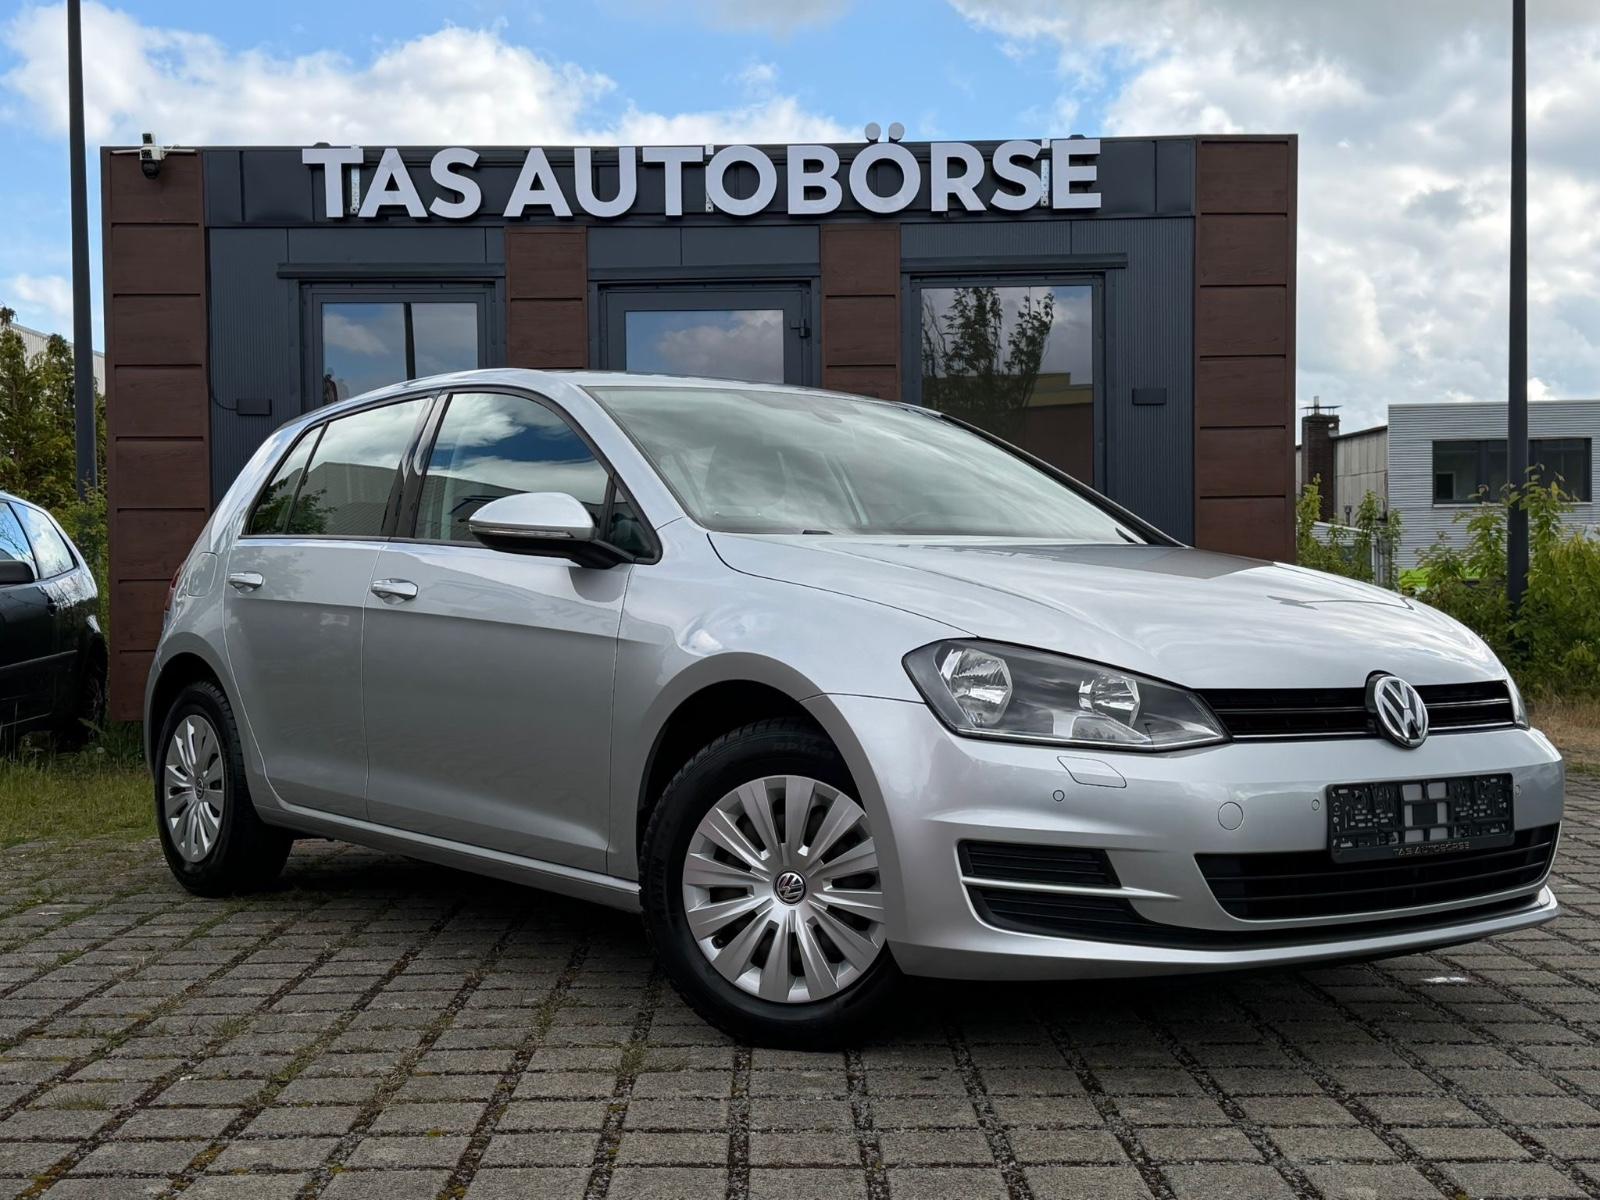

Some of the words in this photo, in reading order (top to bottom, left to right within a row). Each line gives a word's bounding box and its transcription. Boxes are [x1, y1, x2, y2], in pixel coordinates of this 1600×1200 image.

[302, 147, 482, 219] TAS
[502, 122, 1102, 219] AUTOBÖRSE
[1375, 677, 1428, 748] VW
